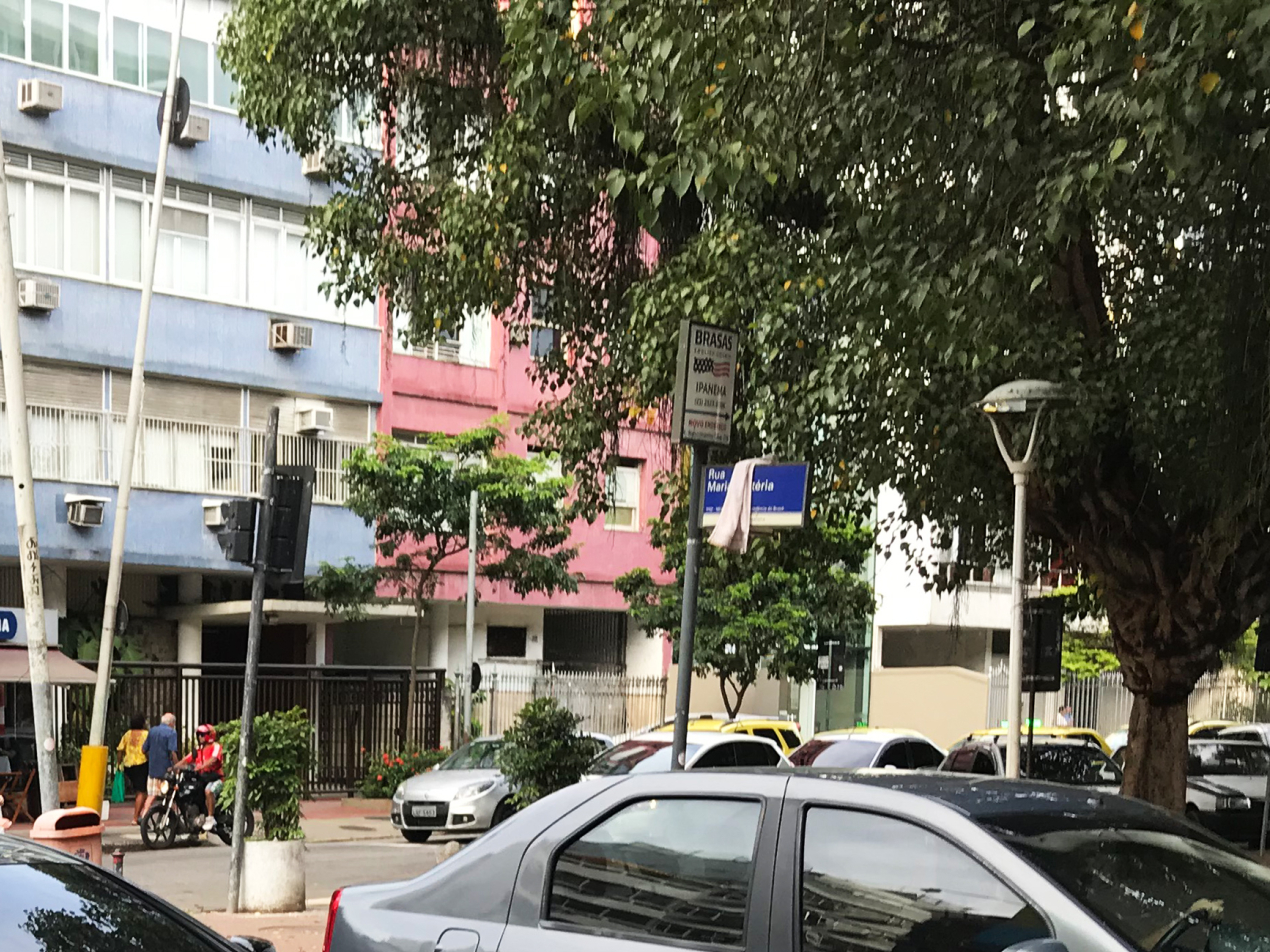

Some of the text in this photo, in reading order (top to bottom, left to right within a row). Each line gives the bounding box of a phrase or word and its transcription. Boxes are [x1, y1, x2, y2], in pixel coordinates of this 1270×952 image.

[695, 330, 732, 350] BRASAS
[696, 382, 727, 396] IPANEMA
[709, 468, 725, 479] Rua
